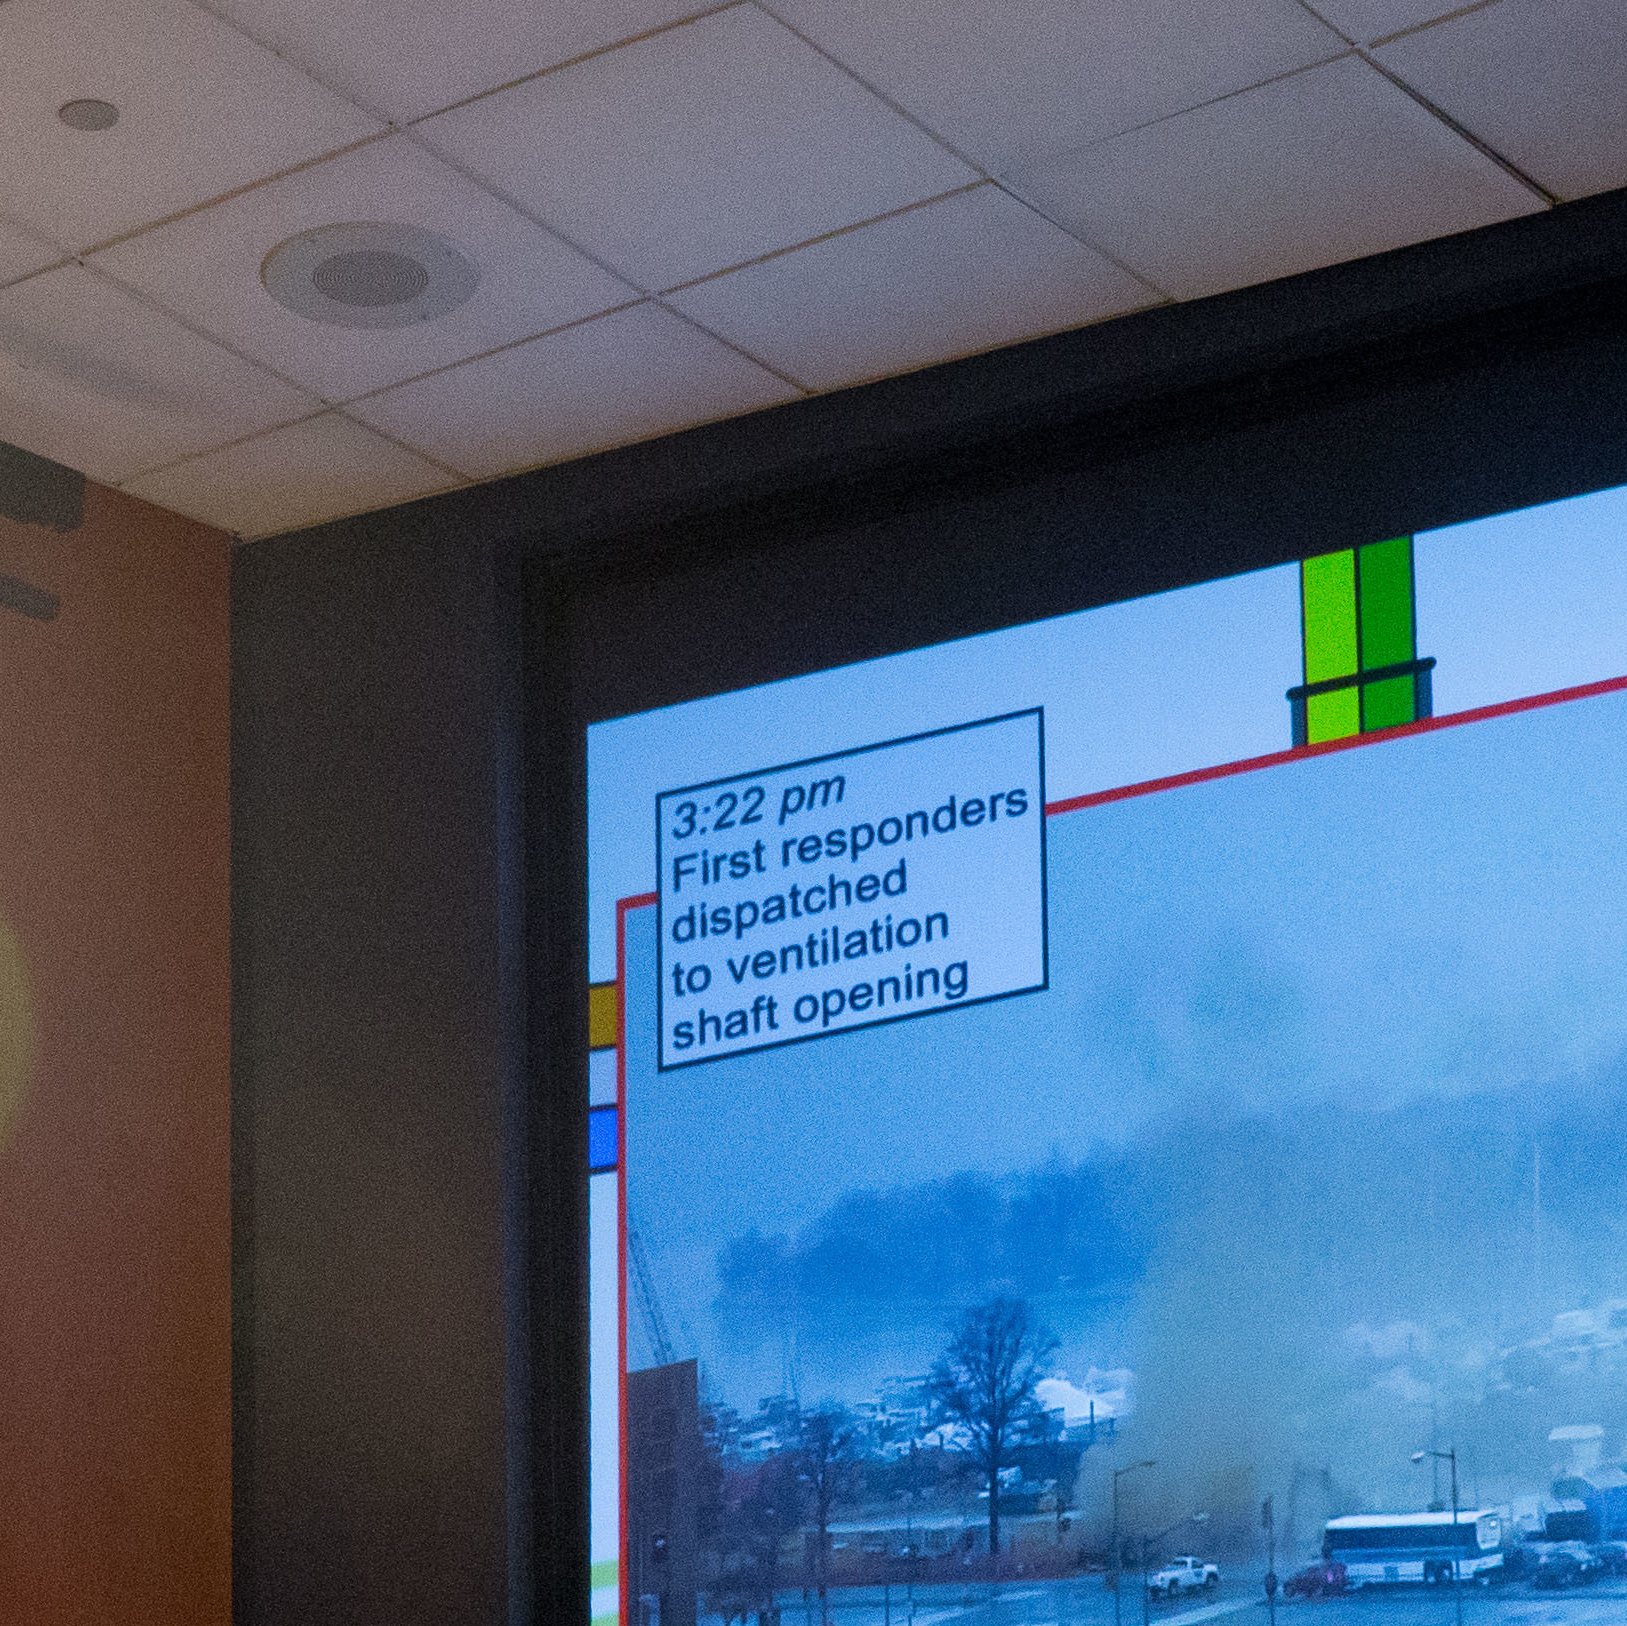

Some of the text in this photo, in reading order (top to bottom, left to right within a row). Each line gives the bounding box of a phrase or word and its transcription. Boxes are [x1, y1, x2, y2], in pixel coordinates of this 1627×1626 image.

[672, 775, 846, 839] 3:22 pm
[673, 788, 1028, 891] First responders
[673, 858, 907, 944] dispatched
[672, 912, 950, 996] to ventilation
[673, 960, 968, 1049] shaft opening
